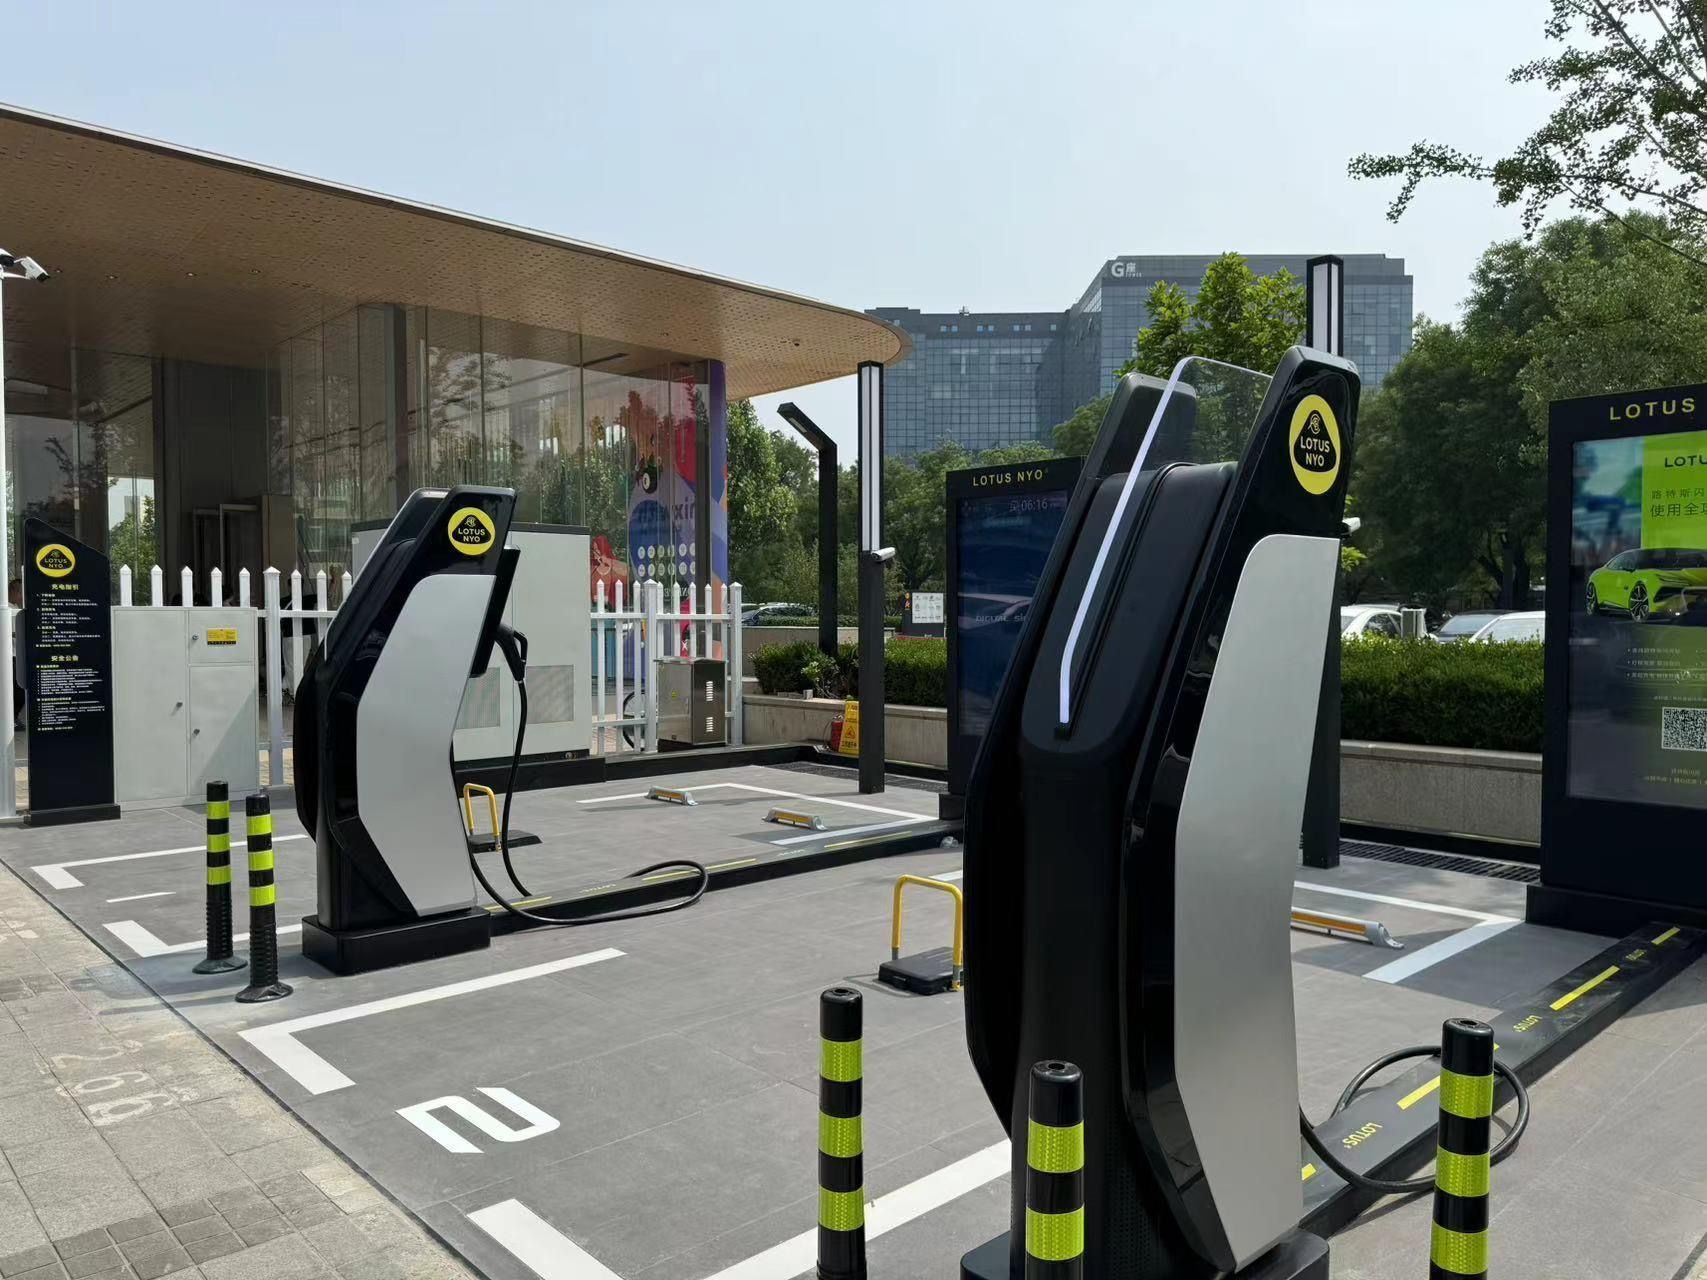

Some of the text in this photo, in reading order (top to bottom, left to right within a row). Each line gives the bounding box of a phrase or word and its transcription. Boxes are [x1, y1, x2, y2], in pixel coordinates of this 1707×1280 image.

[1609, 398, 1695, 420] LOTUS
[1300, 436, 1330, 453] LOTUS
[1305, 453, 1325, 467] NYO
[973, 469, 1043, 487] LOTUS NYO
[458, 528, 485, 536] LOTUS
[1342, 1122, 1383, 1146] LOTUS
